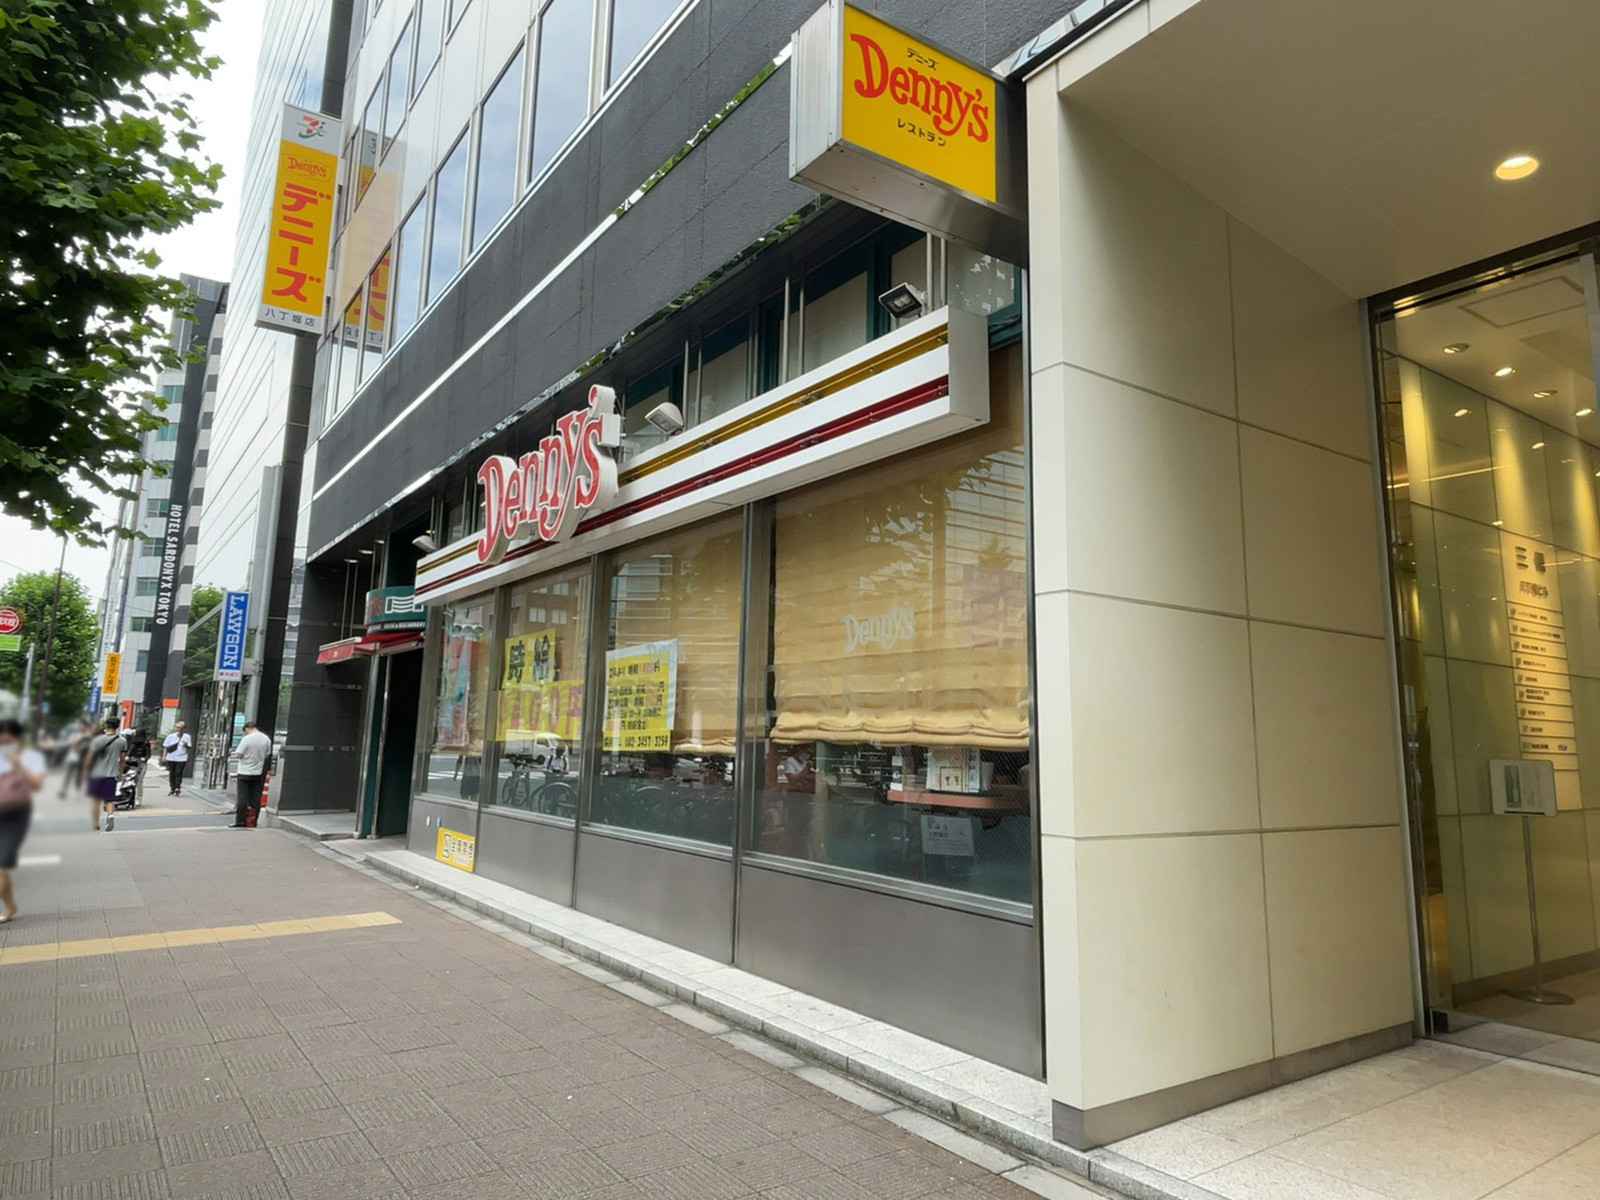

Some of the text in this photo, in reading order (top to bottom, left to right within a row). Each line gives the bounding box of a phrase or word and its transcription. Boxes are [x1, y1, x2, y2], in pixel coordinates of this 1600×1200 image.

[849, 33, 989, 143] Denny's
[906, 47, 939, 71] デニーズ
[287, 156, 327, 178] Denny's
[897, 118, 946, 147] レストラン
[271, 182, 332, 303] デニーズ
[477, 384, 608, 564] Denny's
[156, 504, 183, 625] HOTEL SARDONYX TOKYO
[223, 595, 245, 668] LAWSON
[842, 600, 915, 654] Denny's
